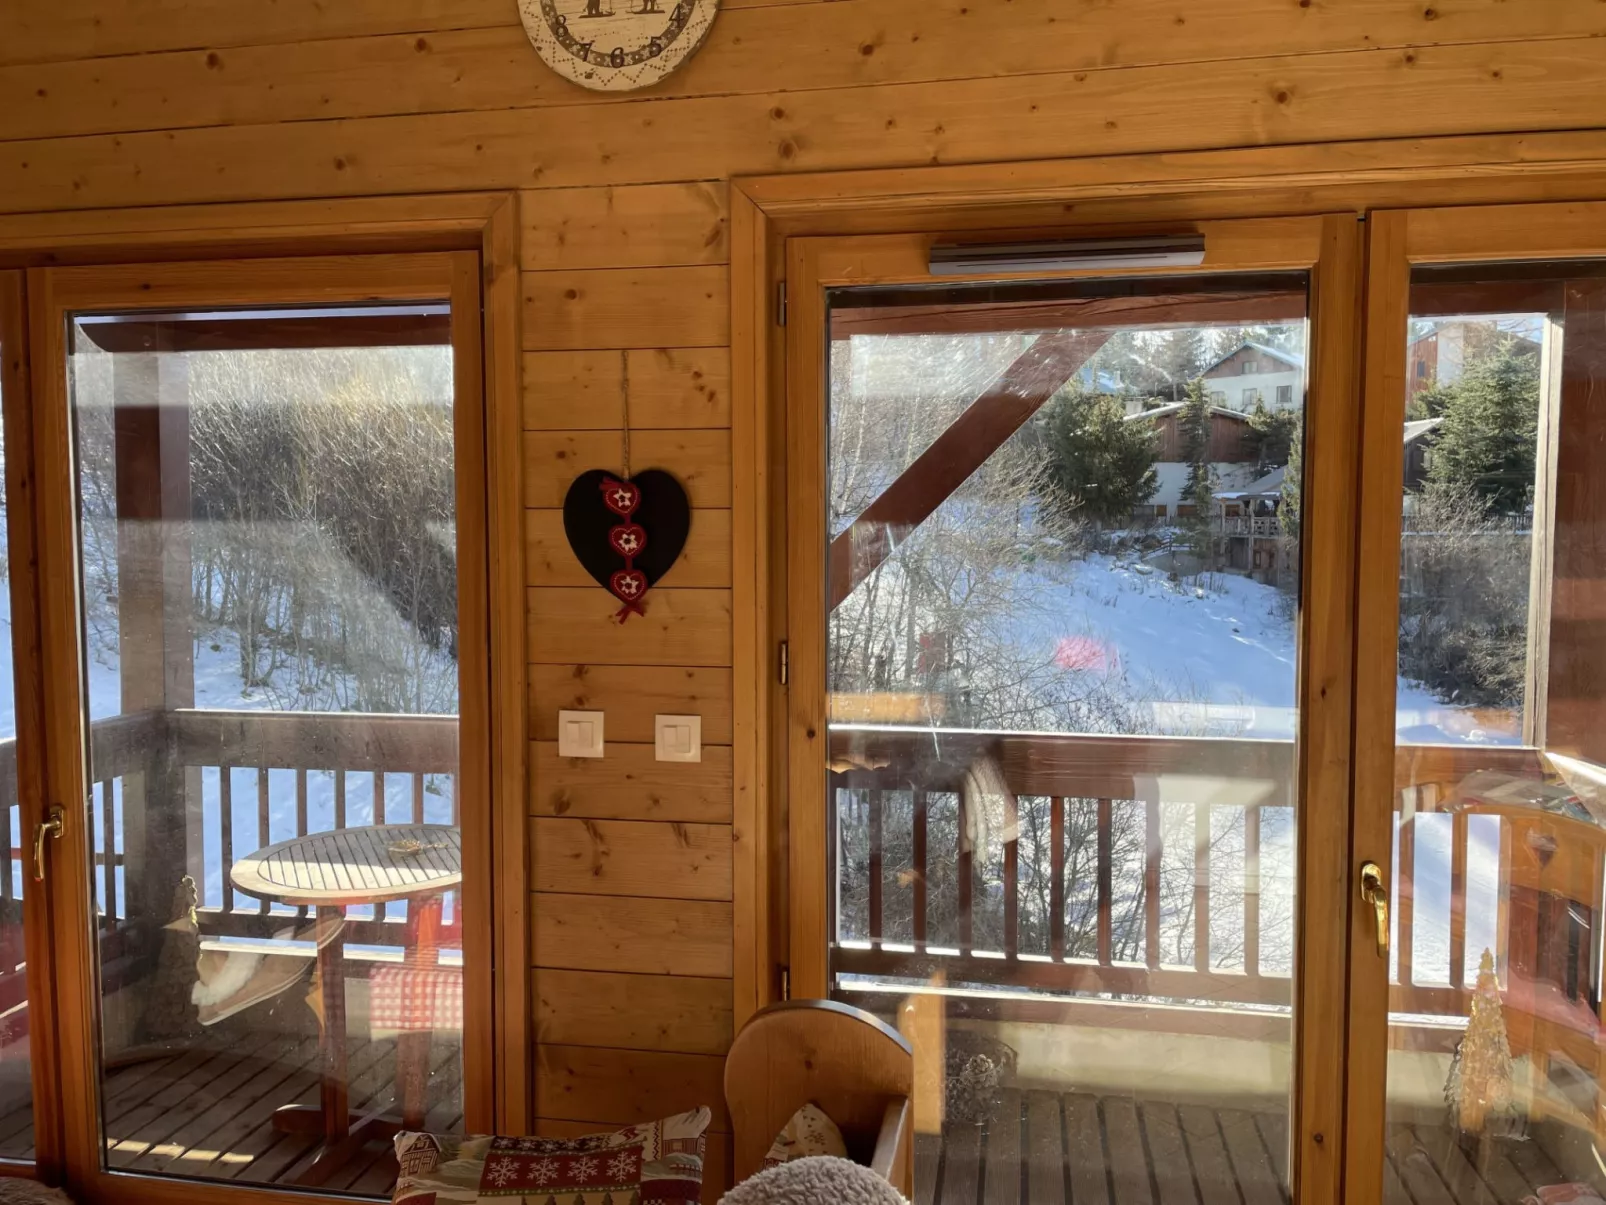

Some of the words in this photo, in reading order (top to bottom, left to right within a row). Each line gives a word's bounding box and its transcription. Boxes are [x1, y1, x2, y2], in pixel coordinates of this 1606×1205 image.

[556, 15, 568, 37] 8
[668, 3, 685, 29] 4
[580, 43, 593, 62] 7
[649, 36, 662, 57] 5
[610, 47, 625, 68] 6
